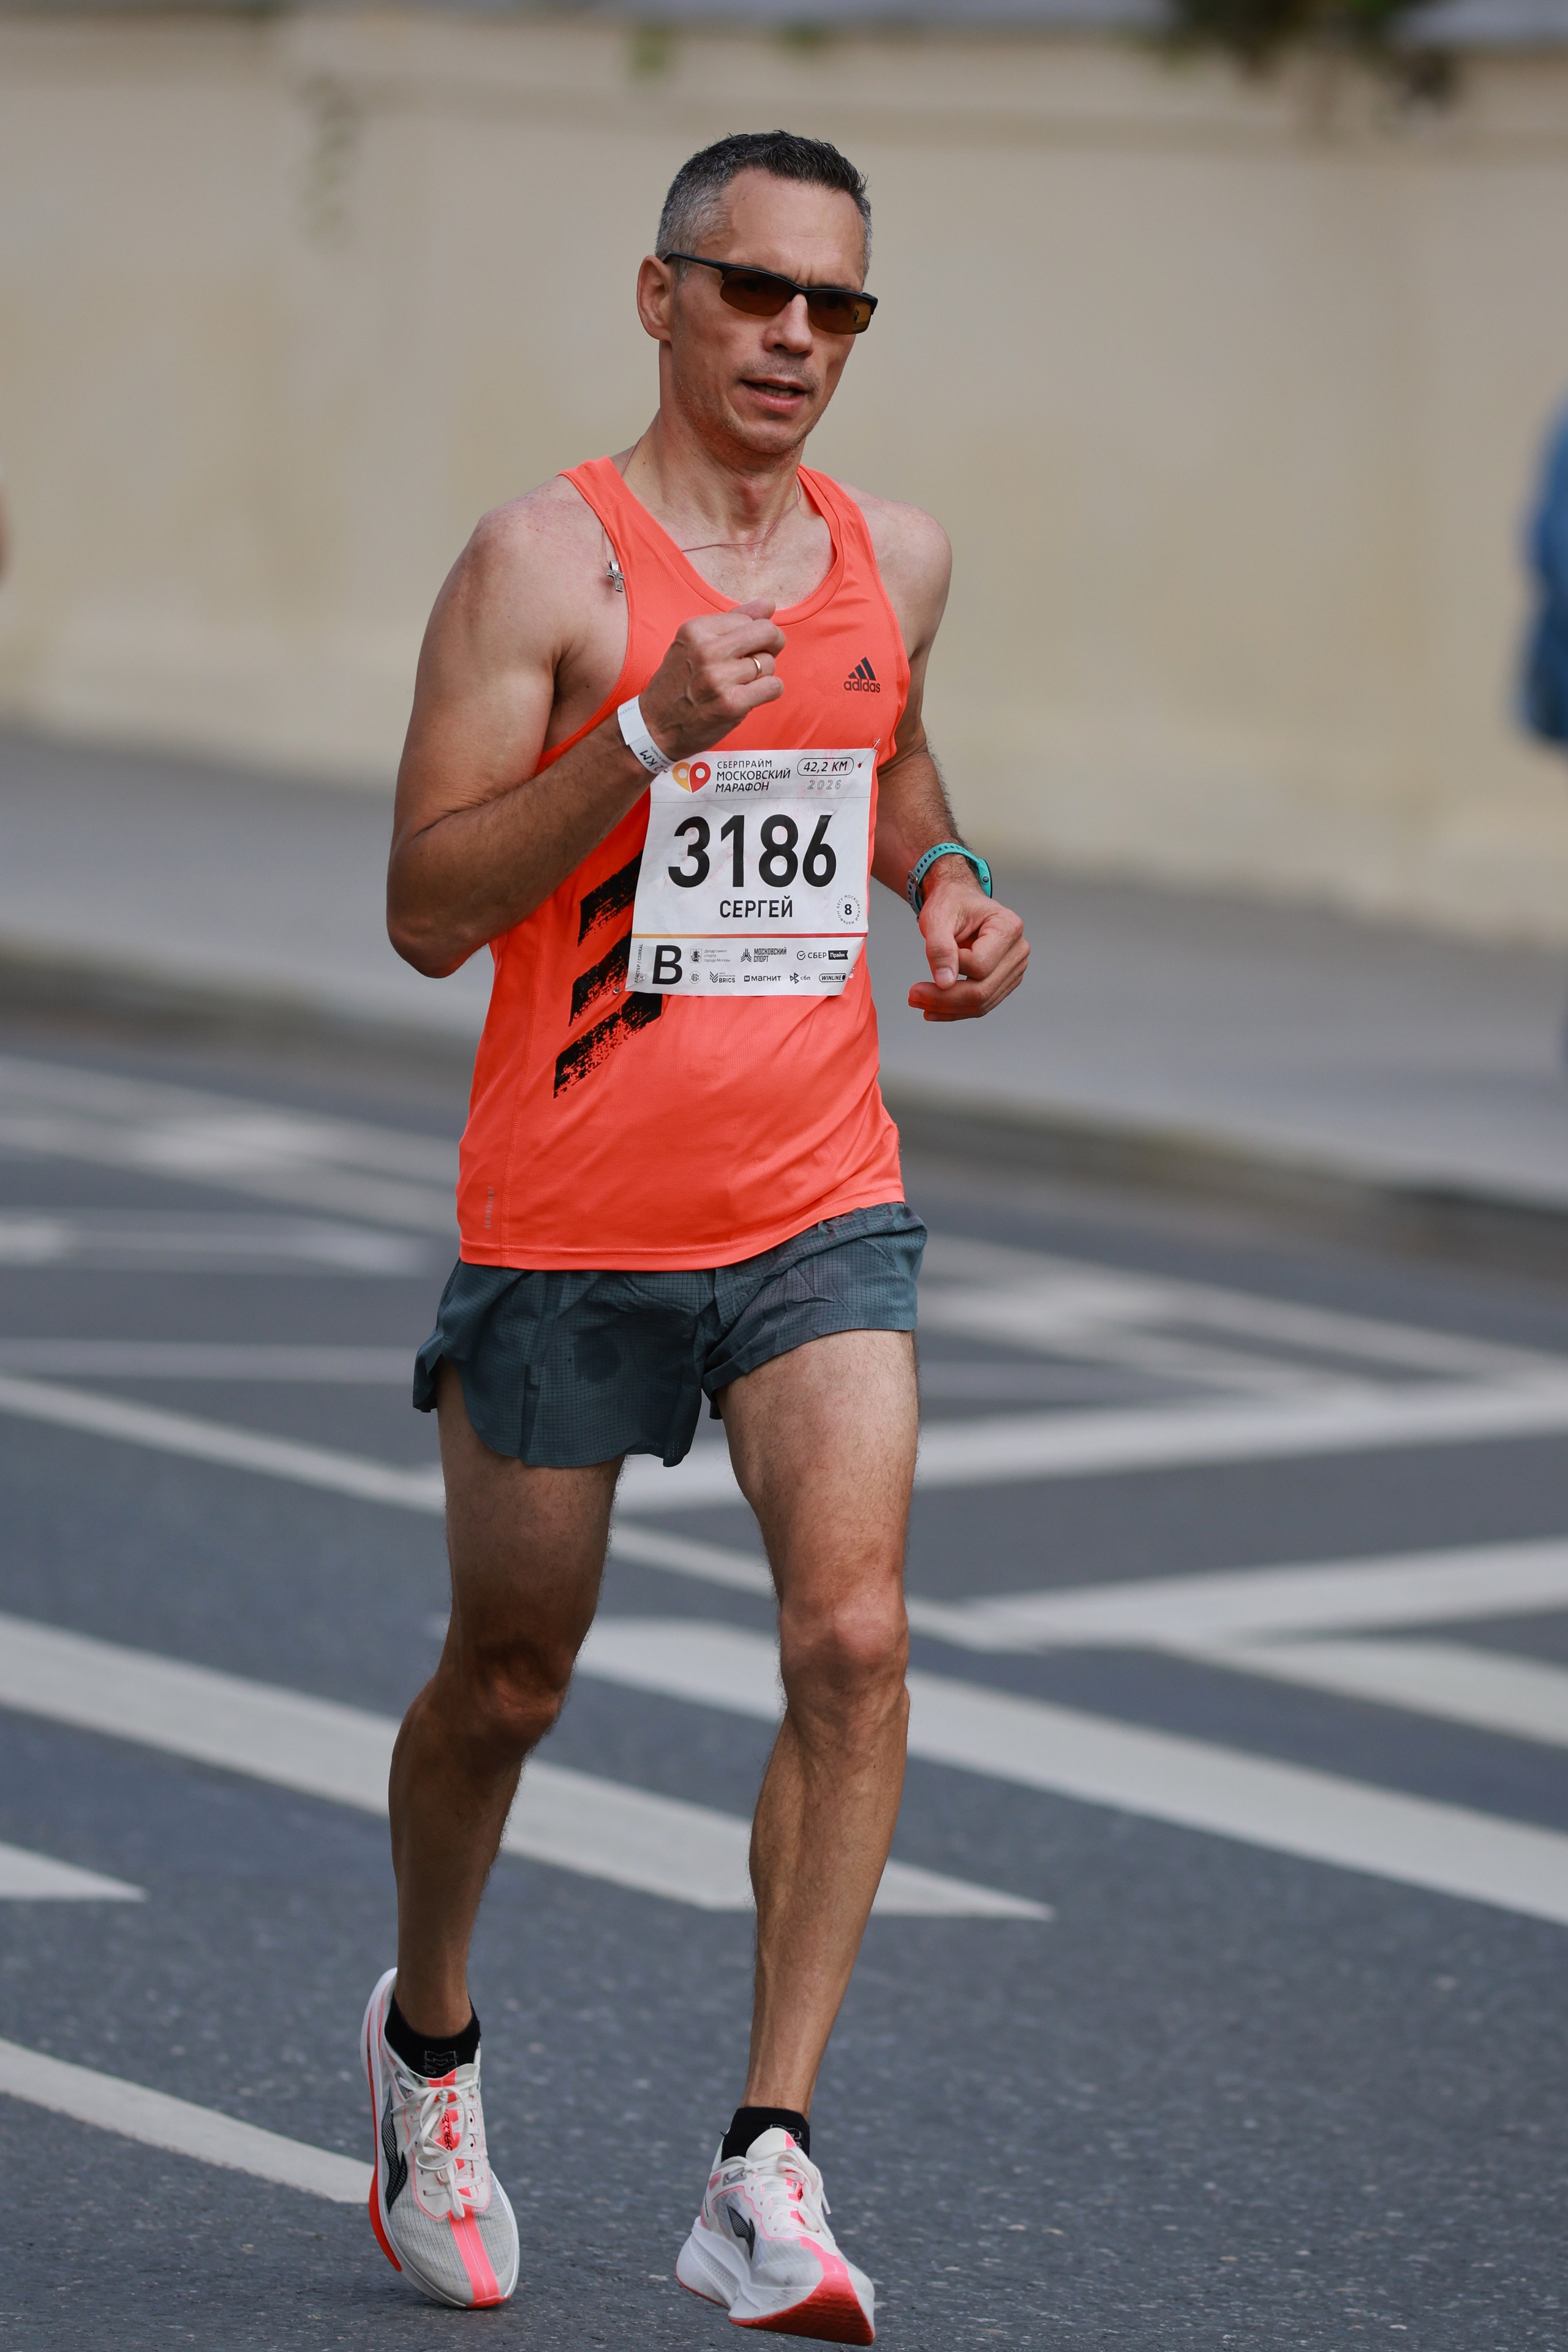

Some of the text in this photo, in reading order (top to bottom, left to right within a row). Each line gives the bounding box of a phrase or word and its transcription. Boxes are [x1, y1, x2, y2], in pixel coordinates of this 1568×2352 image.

[843, 678, 881, 693] adidas
[717, 758, 772, 769] СБЕРПРАЙМ
[803, 761, 827, 774] 42,2
[716, 767, 791, 781] МОСКОВСКИЙ
[715, 782, 769, 793] МАРАФОН
[807, 780, 842, 790] 2026
[668, 814, 837, 888] 3186
[719, 895, 793, 918] СЕРГЕЙ
[844, 903, 852, 916] 8
[754, 946, 787, 955] МОСКОВСКИЙ
